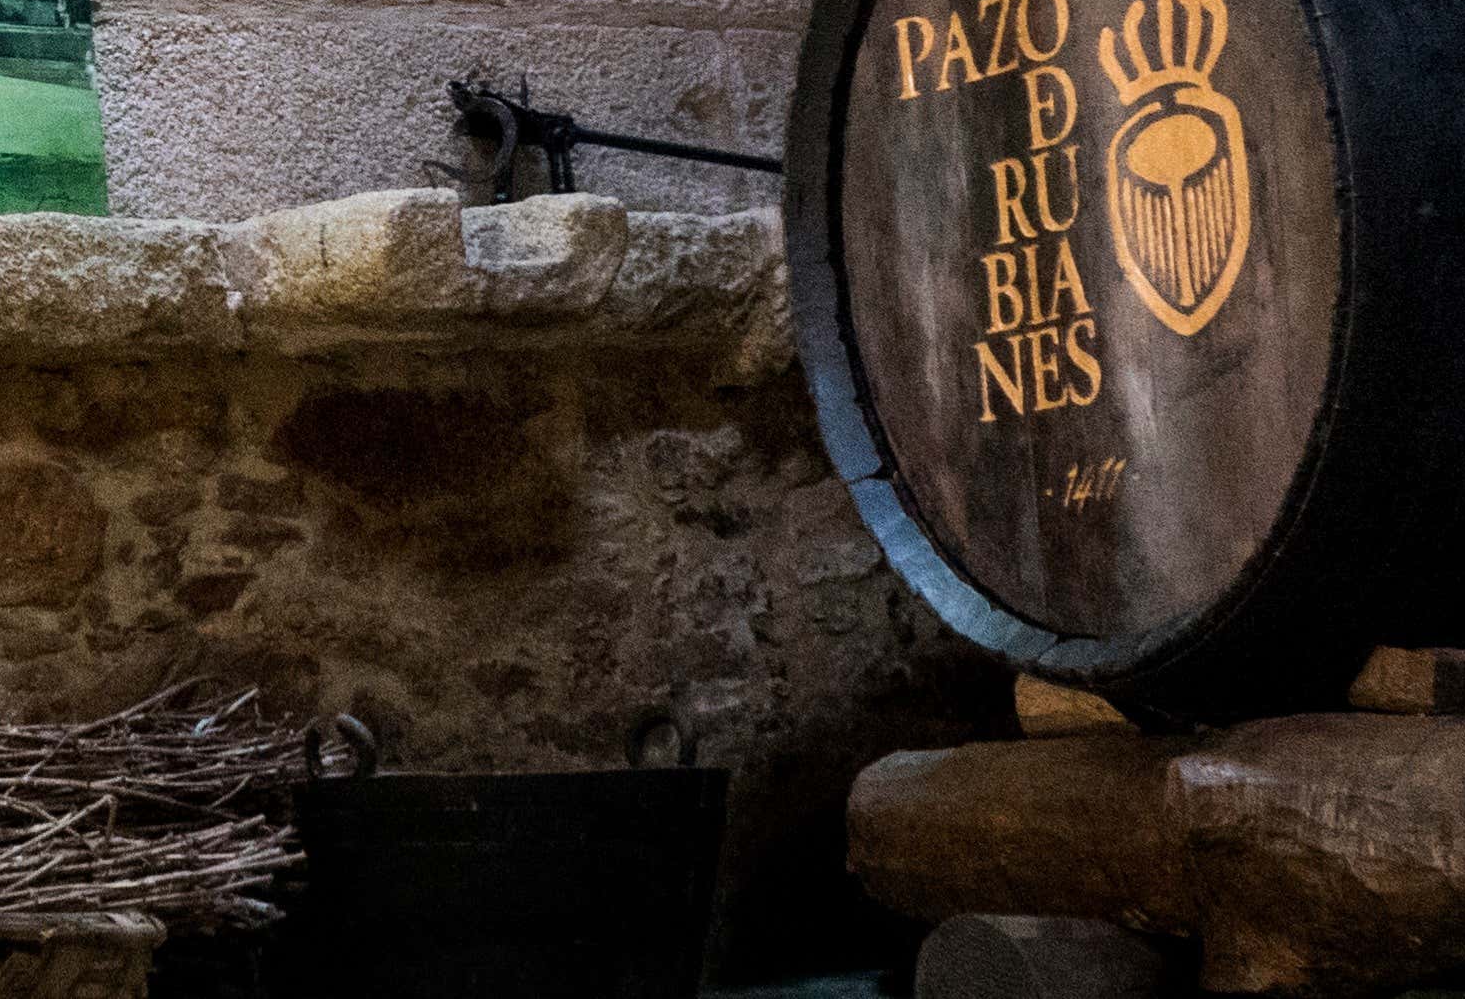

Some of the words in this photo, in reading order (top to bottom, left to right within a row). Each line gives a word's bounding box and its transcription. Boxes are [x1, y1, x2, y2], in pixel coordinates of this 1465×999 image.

[991, 145, 1080, 245] RU
[982, 237, 1094, 334] BIA
[974, 320, 1102, 422] NES
